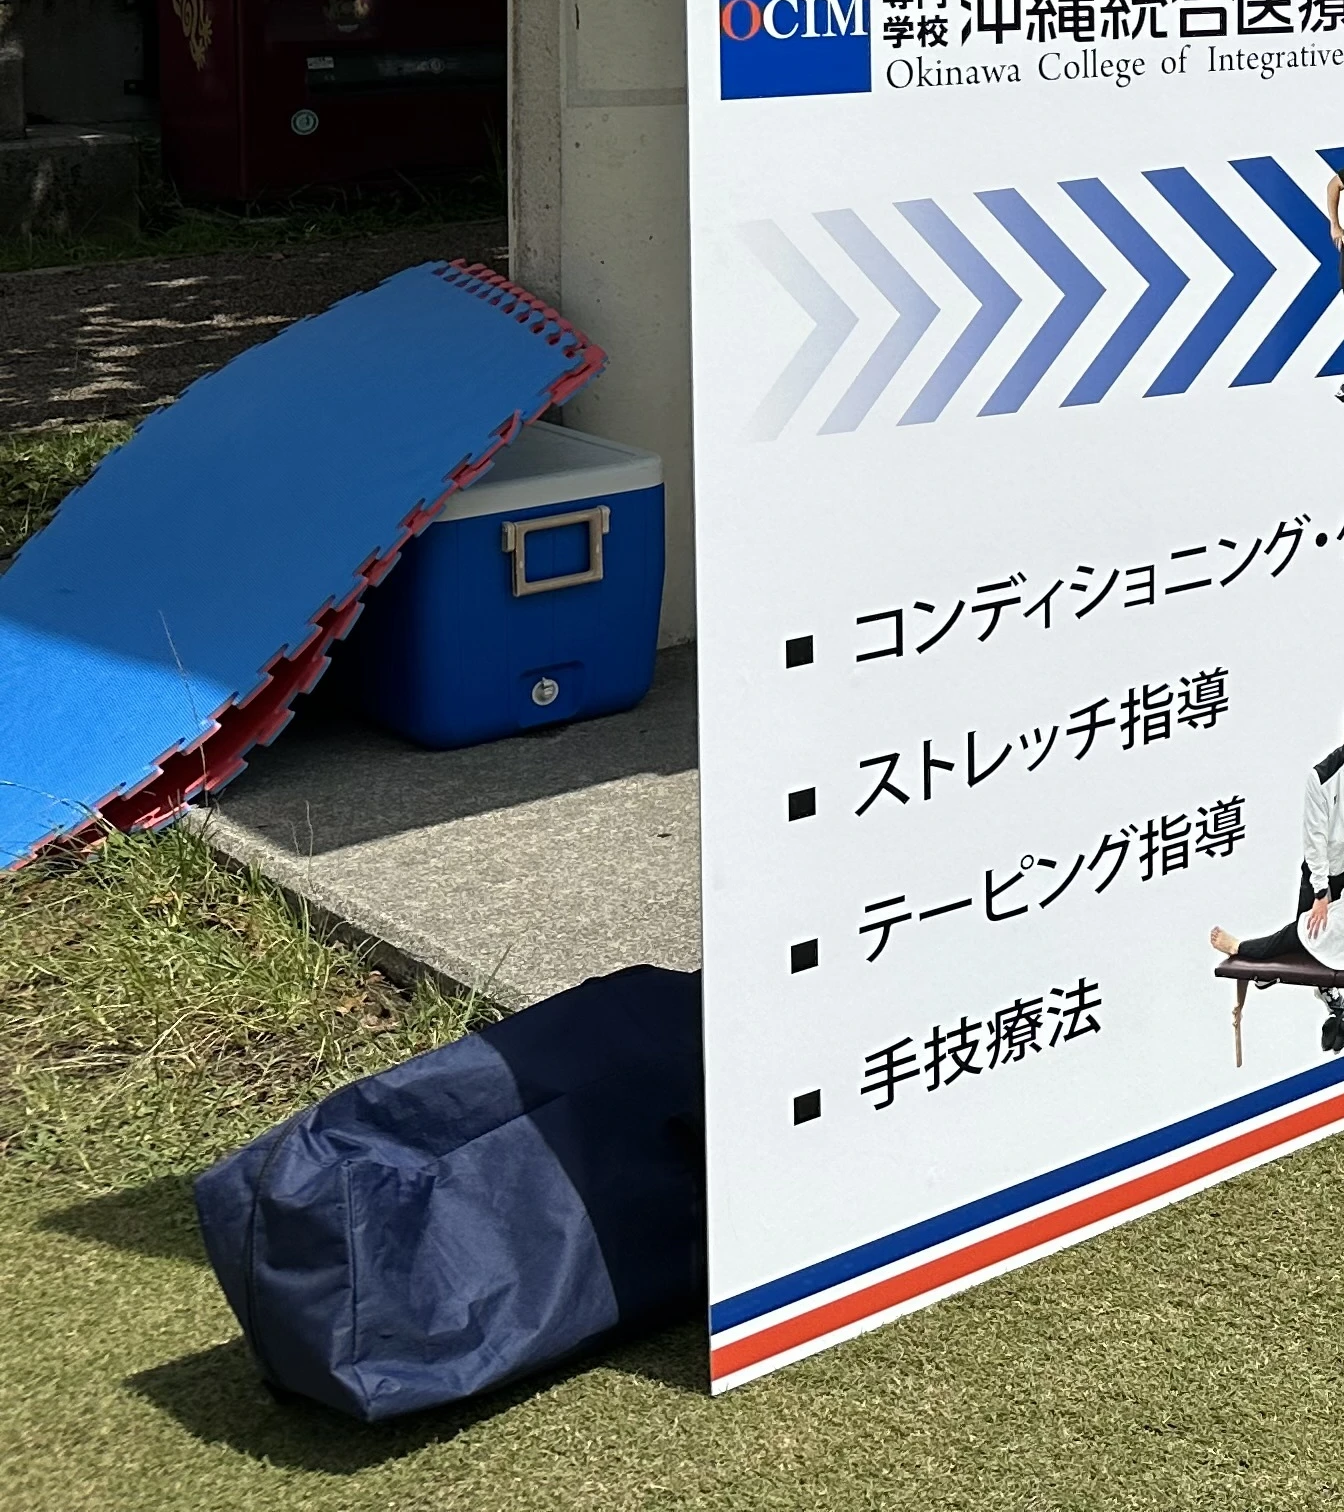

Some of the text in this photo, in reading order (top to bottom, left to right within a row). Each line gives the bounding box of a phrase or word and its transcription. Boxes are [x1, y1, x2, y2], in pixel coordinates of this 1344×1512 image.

[882, 14, 950, 49] 学校
[886, 56, 1022, 90] Okinawa
[1038, 48, 1146, 88] College
[1161, 44, 1191, 75] of
[1208, 42, 1344, 80] Integrative
[854, 666, 1231, 818] ストレッチ指導
[858, 795, 1247, 964] テーピング指導
[860, 977, 1103, 1111] 手技療法
